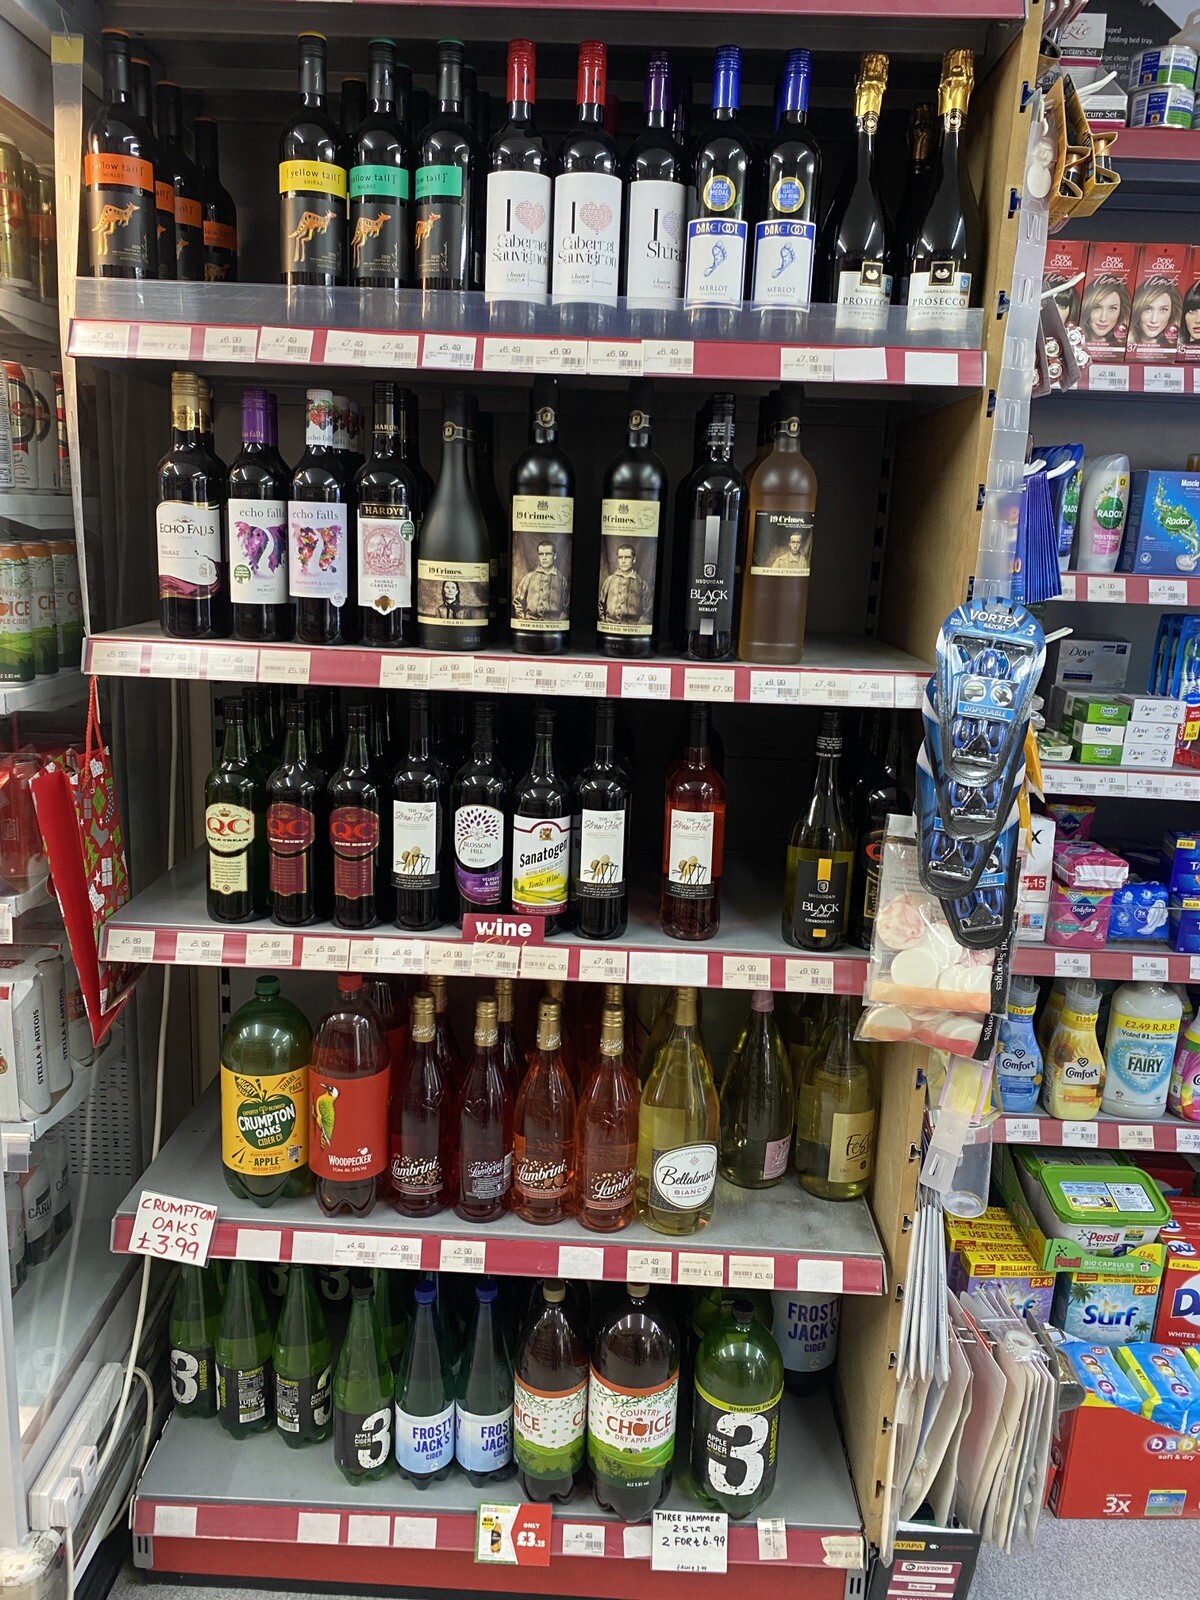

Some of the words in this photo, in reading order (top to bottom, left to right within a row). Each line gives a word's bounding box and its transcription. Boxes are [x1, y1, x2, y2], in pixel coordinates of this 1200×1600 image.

[506, 199, 512, 232] I
[571, 202, 576, 234] I
[653, 209, 659, 242] I
[696, 223, 740, 235] BAREFOOT
[764, 225, 808, 237] BAREFOOT
[497, 234, 548, 252] Cabernet
[562, 236, 615, 254] Cabernet
[492, 250, 548, 266] Sauvignon
[557, 251, 617, 268] Sauvignon
[1106, 256, 1123, 264] POLY
[1152, 263, 1175, 271] COLOR
[843, 297, 890, 307] PROSECCO
[912, 298, 966, 308] PROSECCO
[220, 336, 242, 345] £6.99
[275, 337, 298, 345] £7.49
[342, 340, 364, 348] £7.49
[382, 342, 404, 351] £7.49
[439, 344, 462, 352] £5.49
[499, 346, 522, 354] £6.49
[549, 348, 572, 356] £6.99
[656, 348, 679, 356] £6.49
[606, 350, 628, 359] £6.99
[796, 356, 818, 364] £7.99
[1181, 479, 1200, 488] Muscle
[239, 508, 264, 519] echo
[266, 508, 286, 519] falls
[293, 509, 314, 520] echo
[316, 510, 340, 521] falls
[365, 506, 404, 517] HARDYS
[1097, 510, 1123, 519] RADOX
[1165, 517, 1190, 526] Radox
[160, 523, 185, 534] ECHO
[187, 524, 215, 536] FALLS
[690, 589, 728, 601] BLACK
[970, 609, 1024, 629] VORTEX
[1068, 647, 1095, 659] Dove
[288, 667, 308, 675] £5.99
[395, 664, 416, 672] £9.99
[439, 664, 460, 672] £9.99
[573, 672, 594, 680] £7.99
[637, 674, 658, 682] £7.99
[765, 679, 786, 687] £8.99
[815, 680, 836, 689] £7.49
[858, 682, 880, 690] £7.49
[712, 685, 734, 693] £7.99
[963, 705, 1008, 719] DISPOSABLE
[1101, 707, 1119, 716] Dettol
[1140, 705, 1157, 713] Dove
[1132, 727, 1150, 735] Dove
[1094, 748, 1112, 757] Dettol
[1128, 750, 1146, 758] Dove
[206, 817, 250, 837] QC
[267, 818, 310, 837] QC
[330, 821, 378, 841] QC
[1058, 821, 1080, 832] Bodyform
[470, 848, 484, 856] HILL
[519, 838, 568, 868] Sanatogen
[528, 880, 544, 890] Tonic
[546, 873, 561, 886] Wine
[802, 901, 840, 913] BLACK
[1072, 906, 1096, 916] Bodyform
[475, 919, 532, 937] wine
[121, 937, 142, 945] £5.89
[190, 940, 210, 948] £5.89
[260, 941, 281, 949] £5.89
[316, 946, 336, 954] £5.89
[392, 949, 412, 957] £8.49
[442, 951, 463, 959] £9.99
[486, 951, 506, 960] £7.99
[593, 957, 614, 966] £7.49
[547, 964, 568, 972] £5.99
[736, 964, 757, 973] £9.99
[799, 968, 820, 976] £9.99
[58, 987, 66, 1023] ARTOIS
[1075, 1015, 1092, 1024] £1.99
[33, 1009, 42, 1044] ARTOIS
[1125, 1020, 1151, 1031] £2.49
[1152, 1023, 1176, 1032] R.R.P.
[1121, 1030, 1140, 1039] Voted
[1140, 1032, 1150, 1040] #1
[61, 1027, 70, 1062] STELLA
[37, 1052, 46, 1087] STELLA
[1002, 1058, 1036, 1072] Comfort
[1127, 1056, 1164, 1074] FAIRY
[1065, 1067, 1099, 1080] Comfort
[279, 1074, 298, 1093] SHARE
[289, 1081, 303, 1093] PACK
[238, 1103, 296, 1132] CRUMPTON
[255, 1125, 282, 1139] OAKS
[254, 1157, 280, 1167] APPLE
[328, 1154, 372, 1167] WOODPECKER
[391, 1157, 439, 1180] Lambrini
[517, 1159, 566, 1185] Lambrini
[674, 1186, 708, 1197] BIANCO
[141, 1198, 216, 1221] CRUMPTON
[152, 1217, 198, 1237] OAKS
[968, 1231, 988, 1239] USE
[989, 1232, 1014, 1240] LESS
[1089, 1232, 1120, 1243] Persil
[136, 1232, 200, 1261] £3.99
[347, 1242, 366, 1250] £4.49
[1168, 1243, 1194, 1253] DAZ
[640, 1258, 659, 1266] £3.49
[986, 1254, 1005, 1262] USE
[1007, 1254, 1032, 1262] LESS
[1054, 1257, 1082, 1269] Persil
[1098, 1261, 1135, 1269] CAPSULES
[754, 1273, 774, 1281] £3.49
[1030, 1279, 1054, 1288] £2.49
[1134, 1286, 1158, 1295] £2.49
[1083, 1305, 1140, 1327] Surf
[788, 1318, 837, 1342] JACK'S
[804, 1342, 827, 1354] CIDER
[170, 1350, 199, 1405] 3
[728, 1405, 761, 1413] SHARING
[762, 1399, 778, 1411] PACK
[620, 1408, 662, 1418] COUNTRY
[412, 1415, 453, 1441] FROSTY
[606, 1411, 672, 1437] CHOICE
[354, 1438, 372, 1446] CIDER
[358, 1408, 392, 1470] 3
[615, 1435, 629, 1443] DRY
[652, 1430, 670, 1441] CIDER
[707, 1433, 728, 1448] APPLE
[414, 1432, 450, 1454] JACK'S
[706, 1439, 727, 1456] CIDER
[426, 1451, 443, 1461] CIDER
[493, 1448, 508, 1458] CIDER
[707, 1413, 769, 1496] 3
[1102, 1497, 1132, 1514] 3x
[655, 1513, 682, 1523] THREE
[685, 1515, 722, 1524] HAMMER
[690, 1526, 712, 1534] LTR
[662, 1537, 671, 1548] 2
[674, 1538, 692, 1547] FOR
[917, 1565, 950, 1573] payzone
